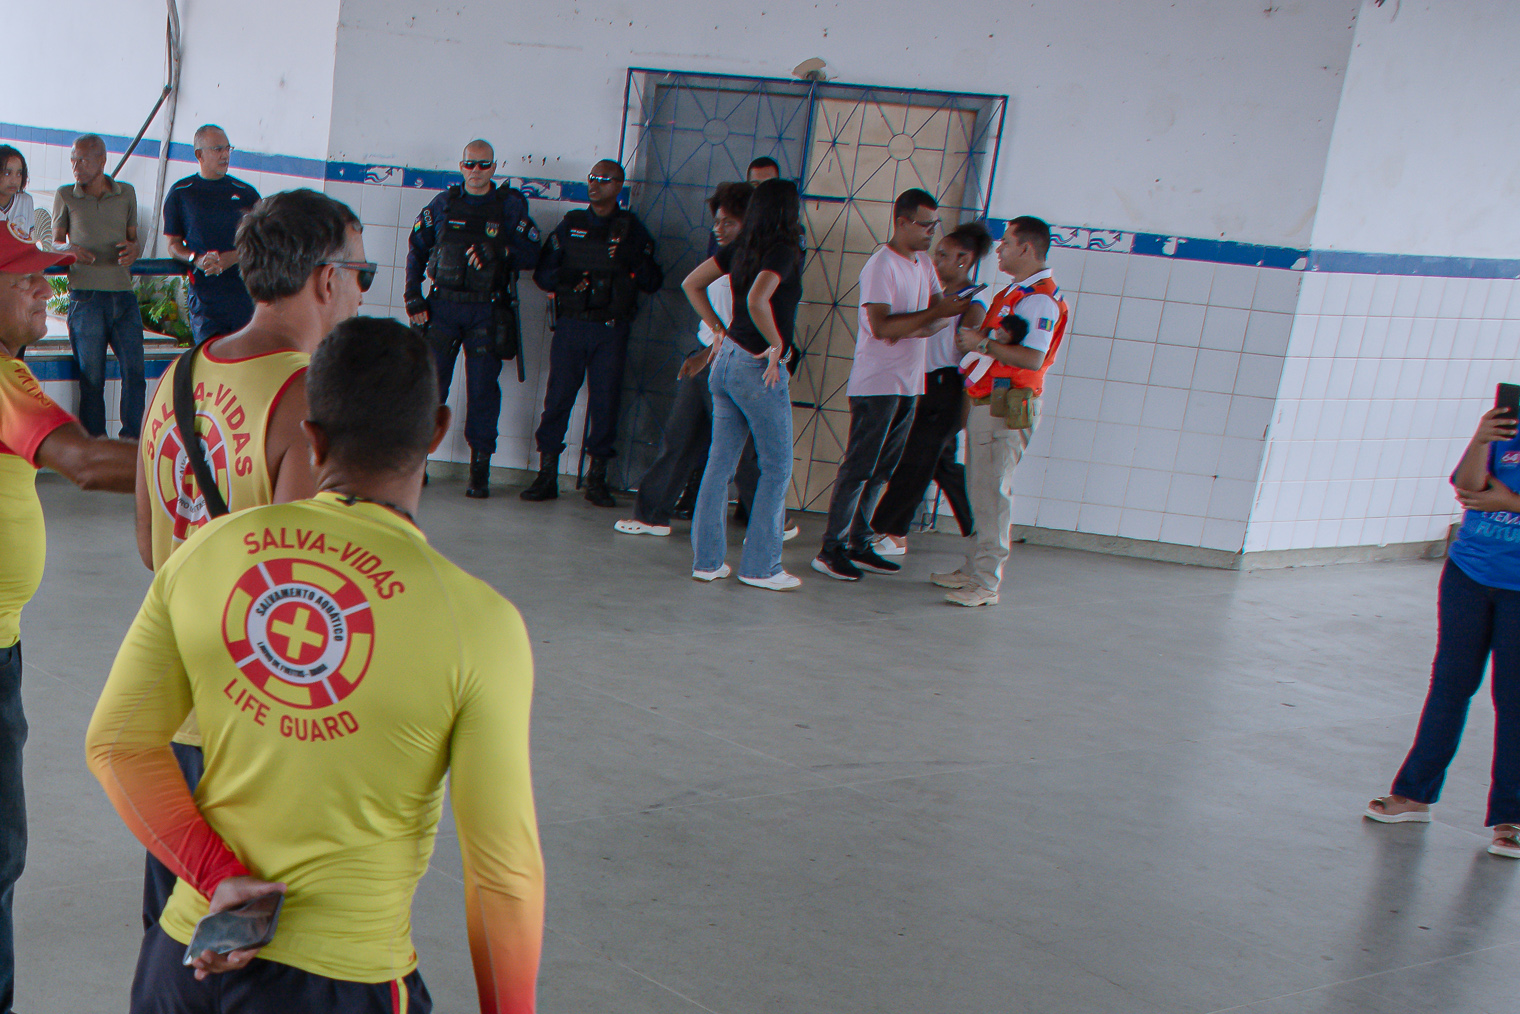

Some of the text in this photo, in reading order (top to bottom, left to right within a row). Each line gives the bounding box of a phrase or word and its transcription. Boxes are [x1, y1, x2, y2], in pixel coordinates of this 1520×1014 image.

[147, 382, 253, 478] SALA-VIDAS
[243, 527, 406, 600] SALVA-VIDAS
[256, 588, 316, 617] SALVAMENTO
[223, 678, 360, 742] LIFE GUARD
